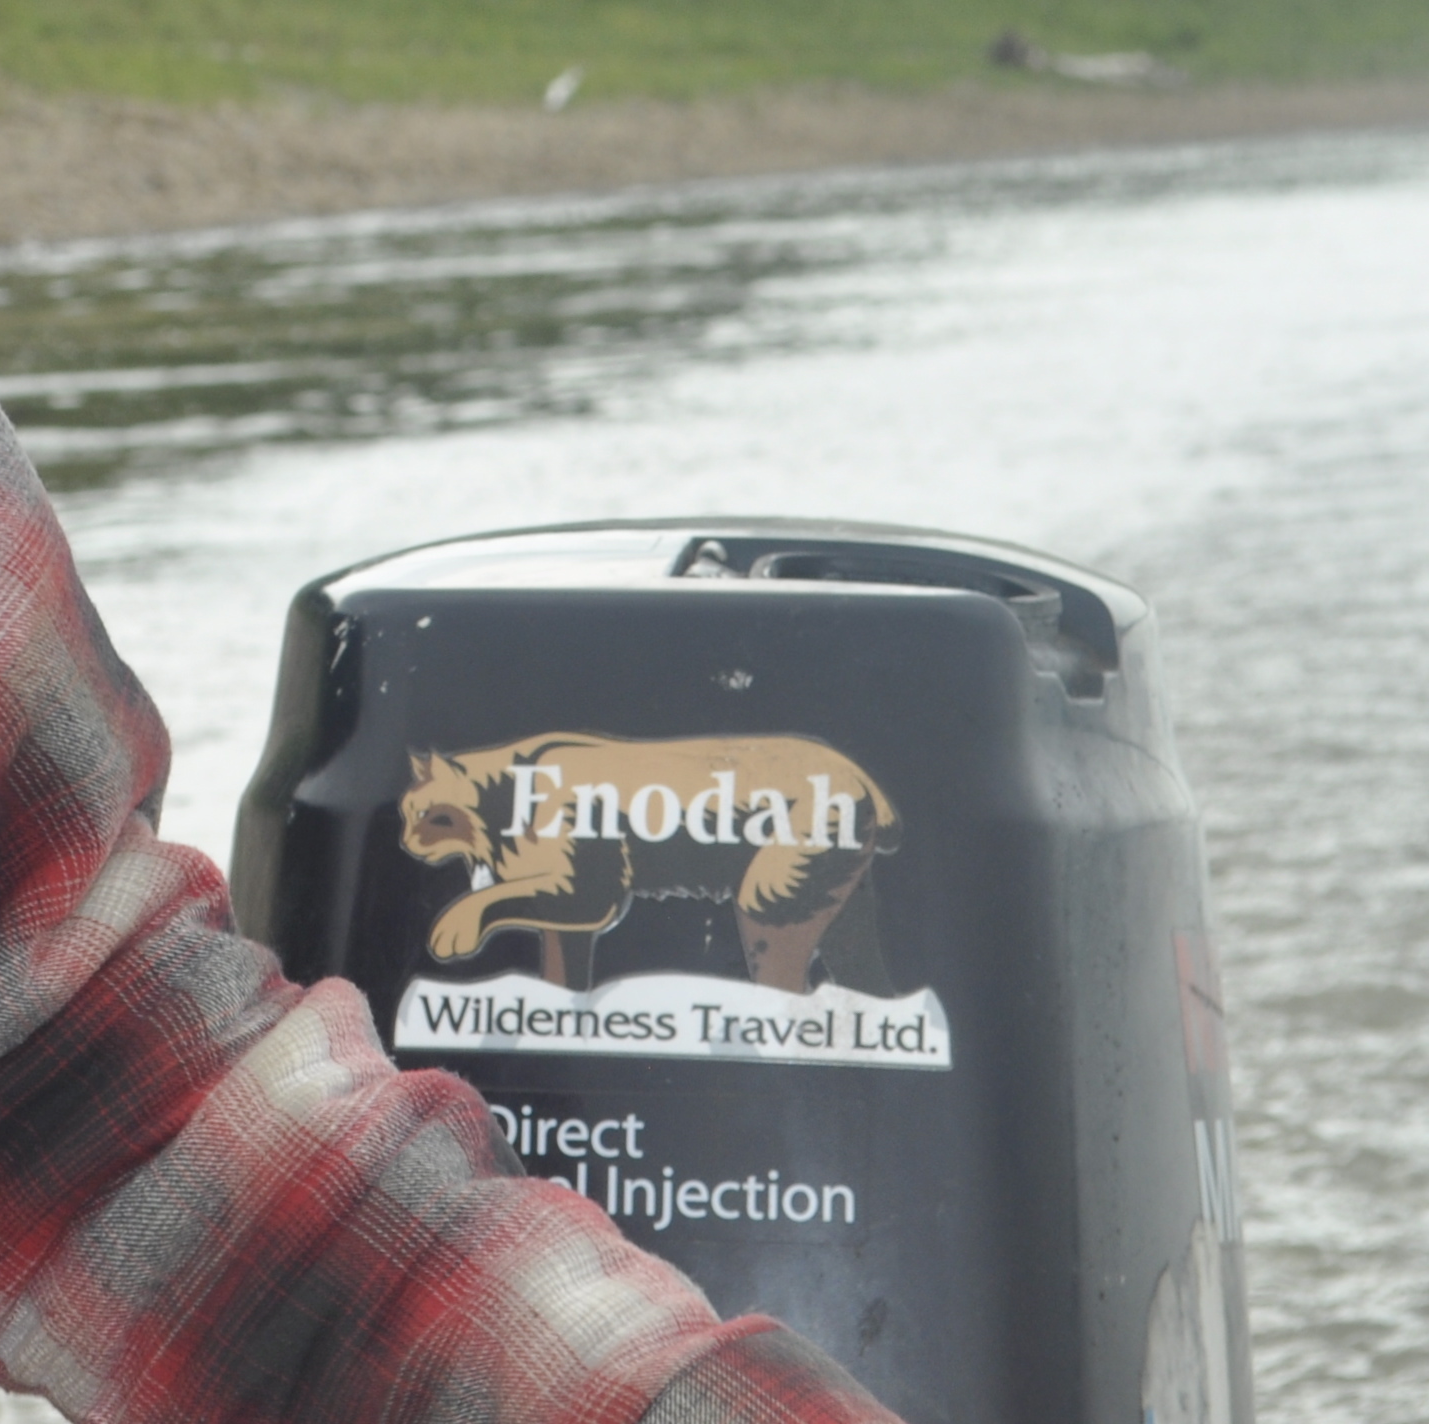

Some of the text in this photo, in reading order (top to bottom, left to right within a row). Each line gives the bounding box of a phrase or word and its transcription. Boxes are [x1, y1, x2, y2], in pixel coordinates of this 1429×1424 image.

[501, 764, 862, 850] Enodah
[420, 994, 939, 1055] Wilderness Travel Ltd.
[607, 1165, 855, 1231] Injection
